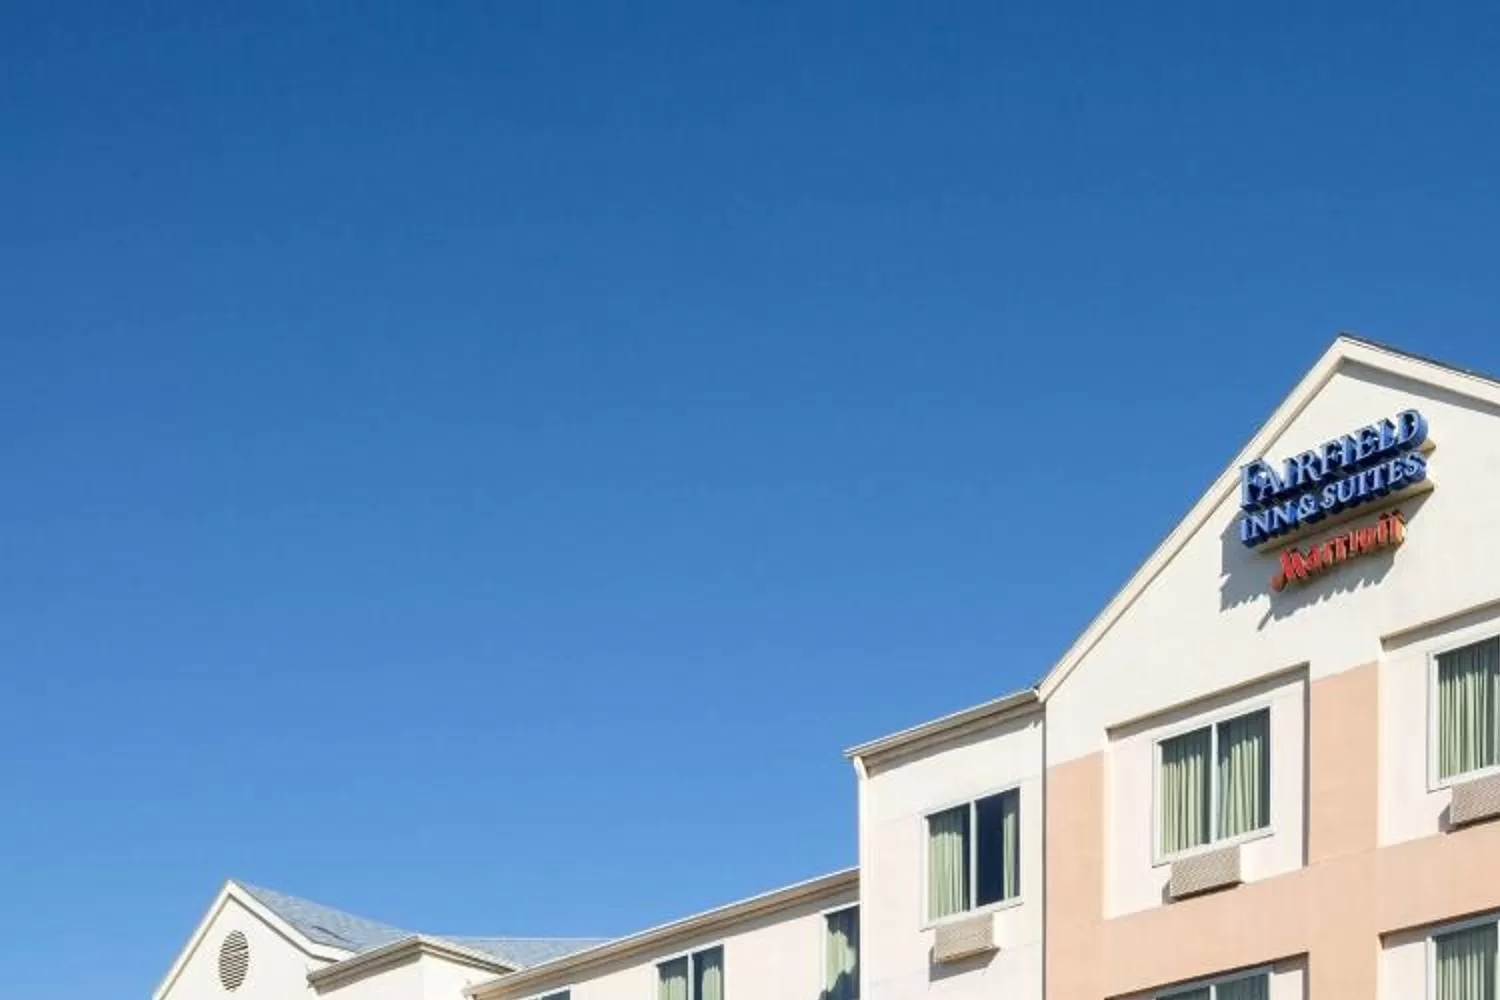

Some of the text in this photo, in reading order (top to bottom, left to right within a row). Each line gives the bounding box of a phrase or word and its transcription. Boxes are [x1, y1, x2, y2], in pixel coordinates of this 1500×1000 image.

[1239, 408, 1429, 508] FAIRFIELD
[1239, 451, 1427, 547] INN & SUITES
